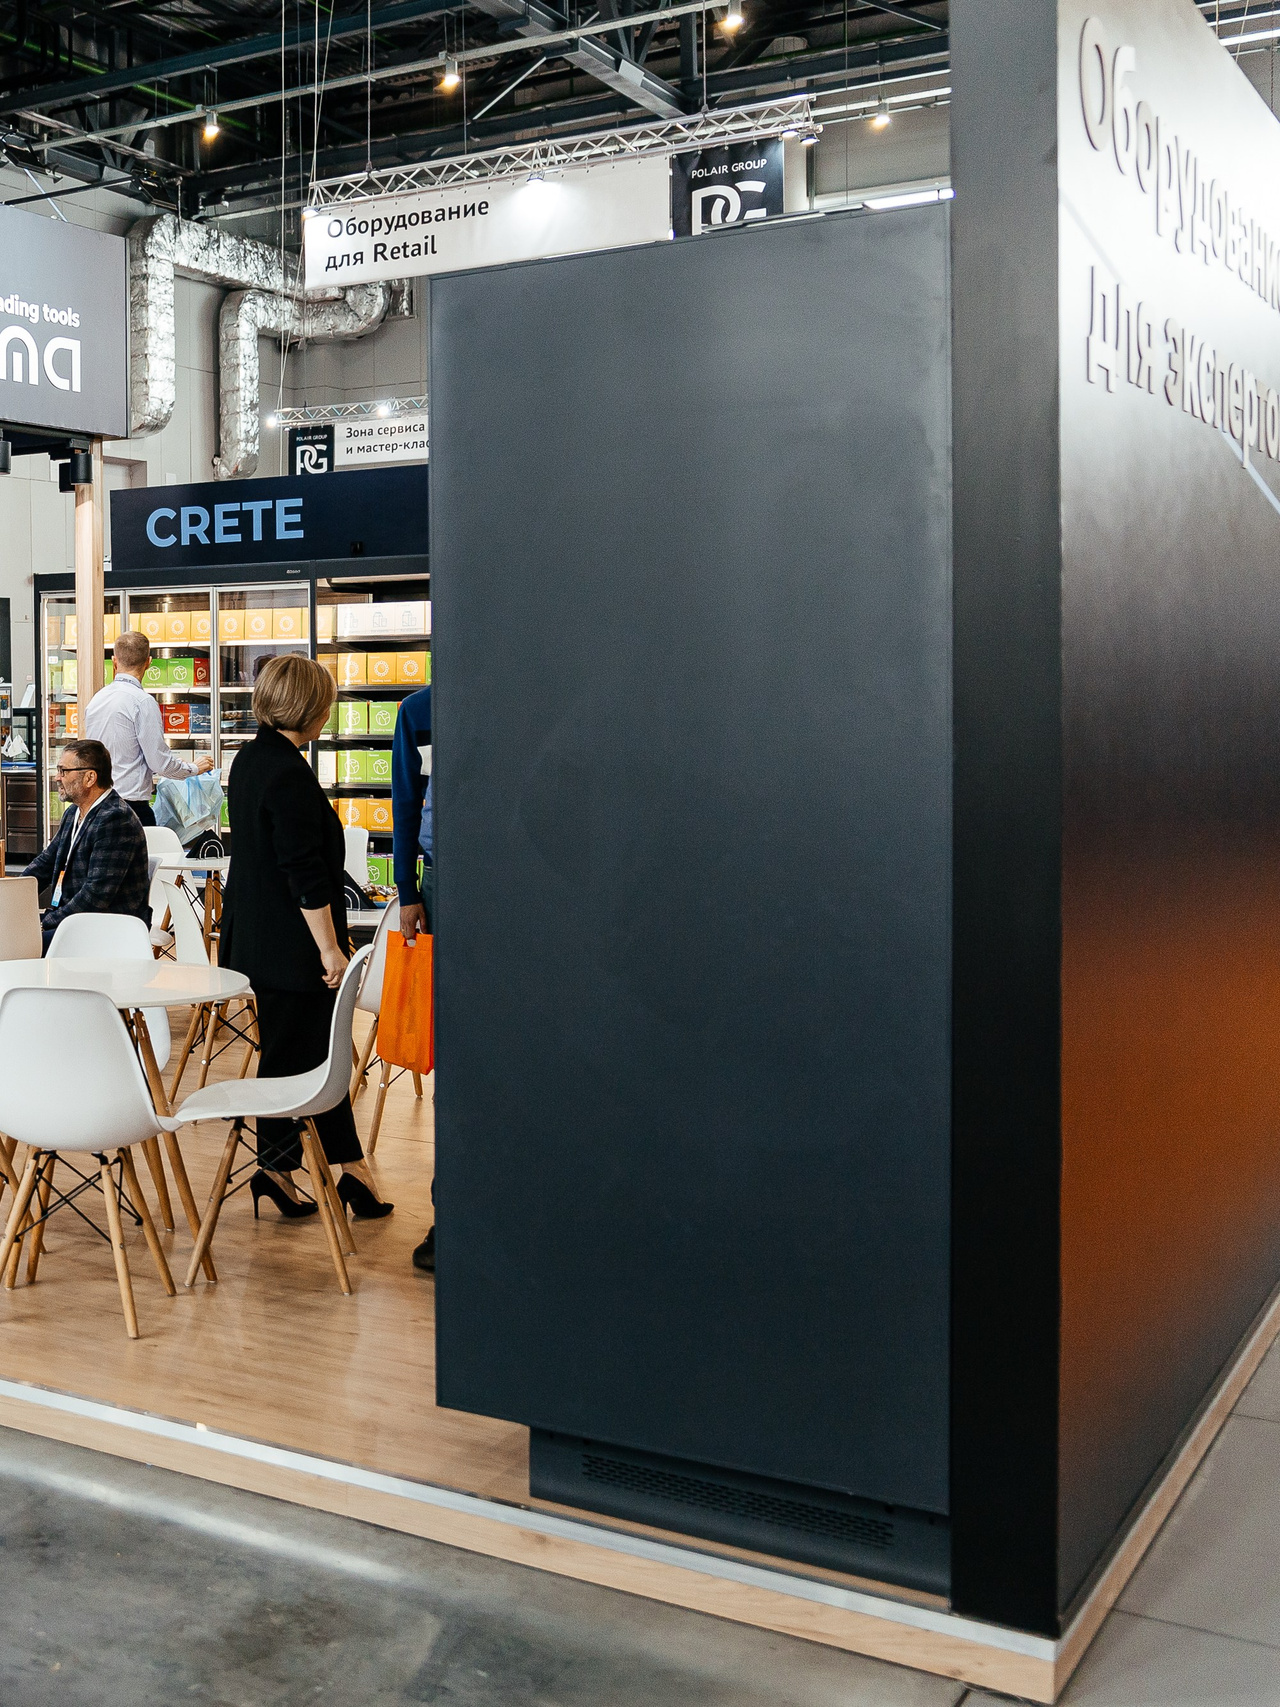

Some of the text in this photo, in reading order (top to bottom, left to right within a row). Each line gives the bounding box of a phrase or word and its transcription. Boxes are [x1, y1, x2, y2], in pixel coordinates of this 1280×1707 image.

[691, 158, 768, 179] POLAIR GROUP
[1079, 16, 1280, 313] Оборудовани
[326, 200, 490, 239] Оборудование
[325, 235, 438, 272] для Retail
[42, 302, 81, 328] tools
[1163, 316, 1280, 469] эксперто
[345, 423, 425, 439] Зона сервиса
[346, 447, 353, 455] и
[145, 497, 305, 548] CRETE
